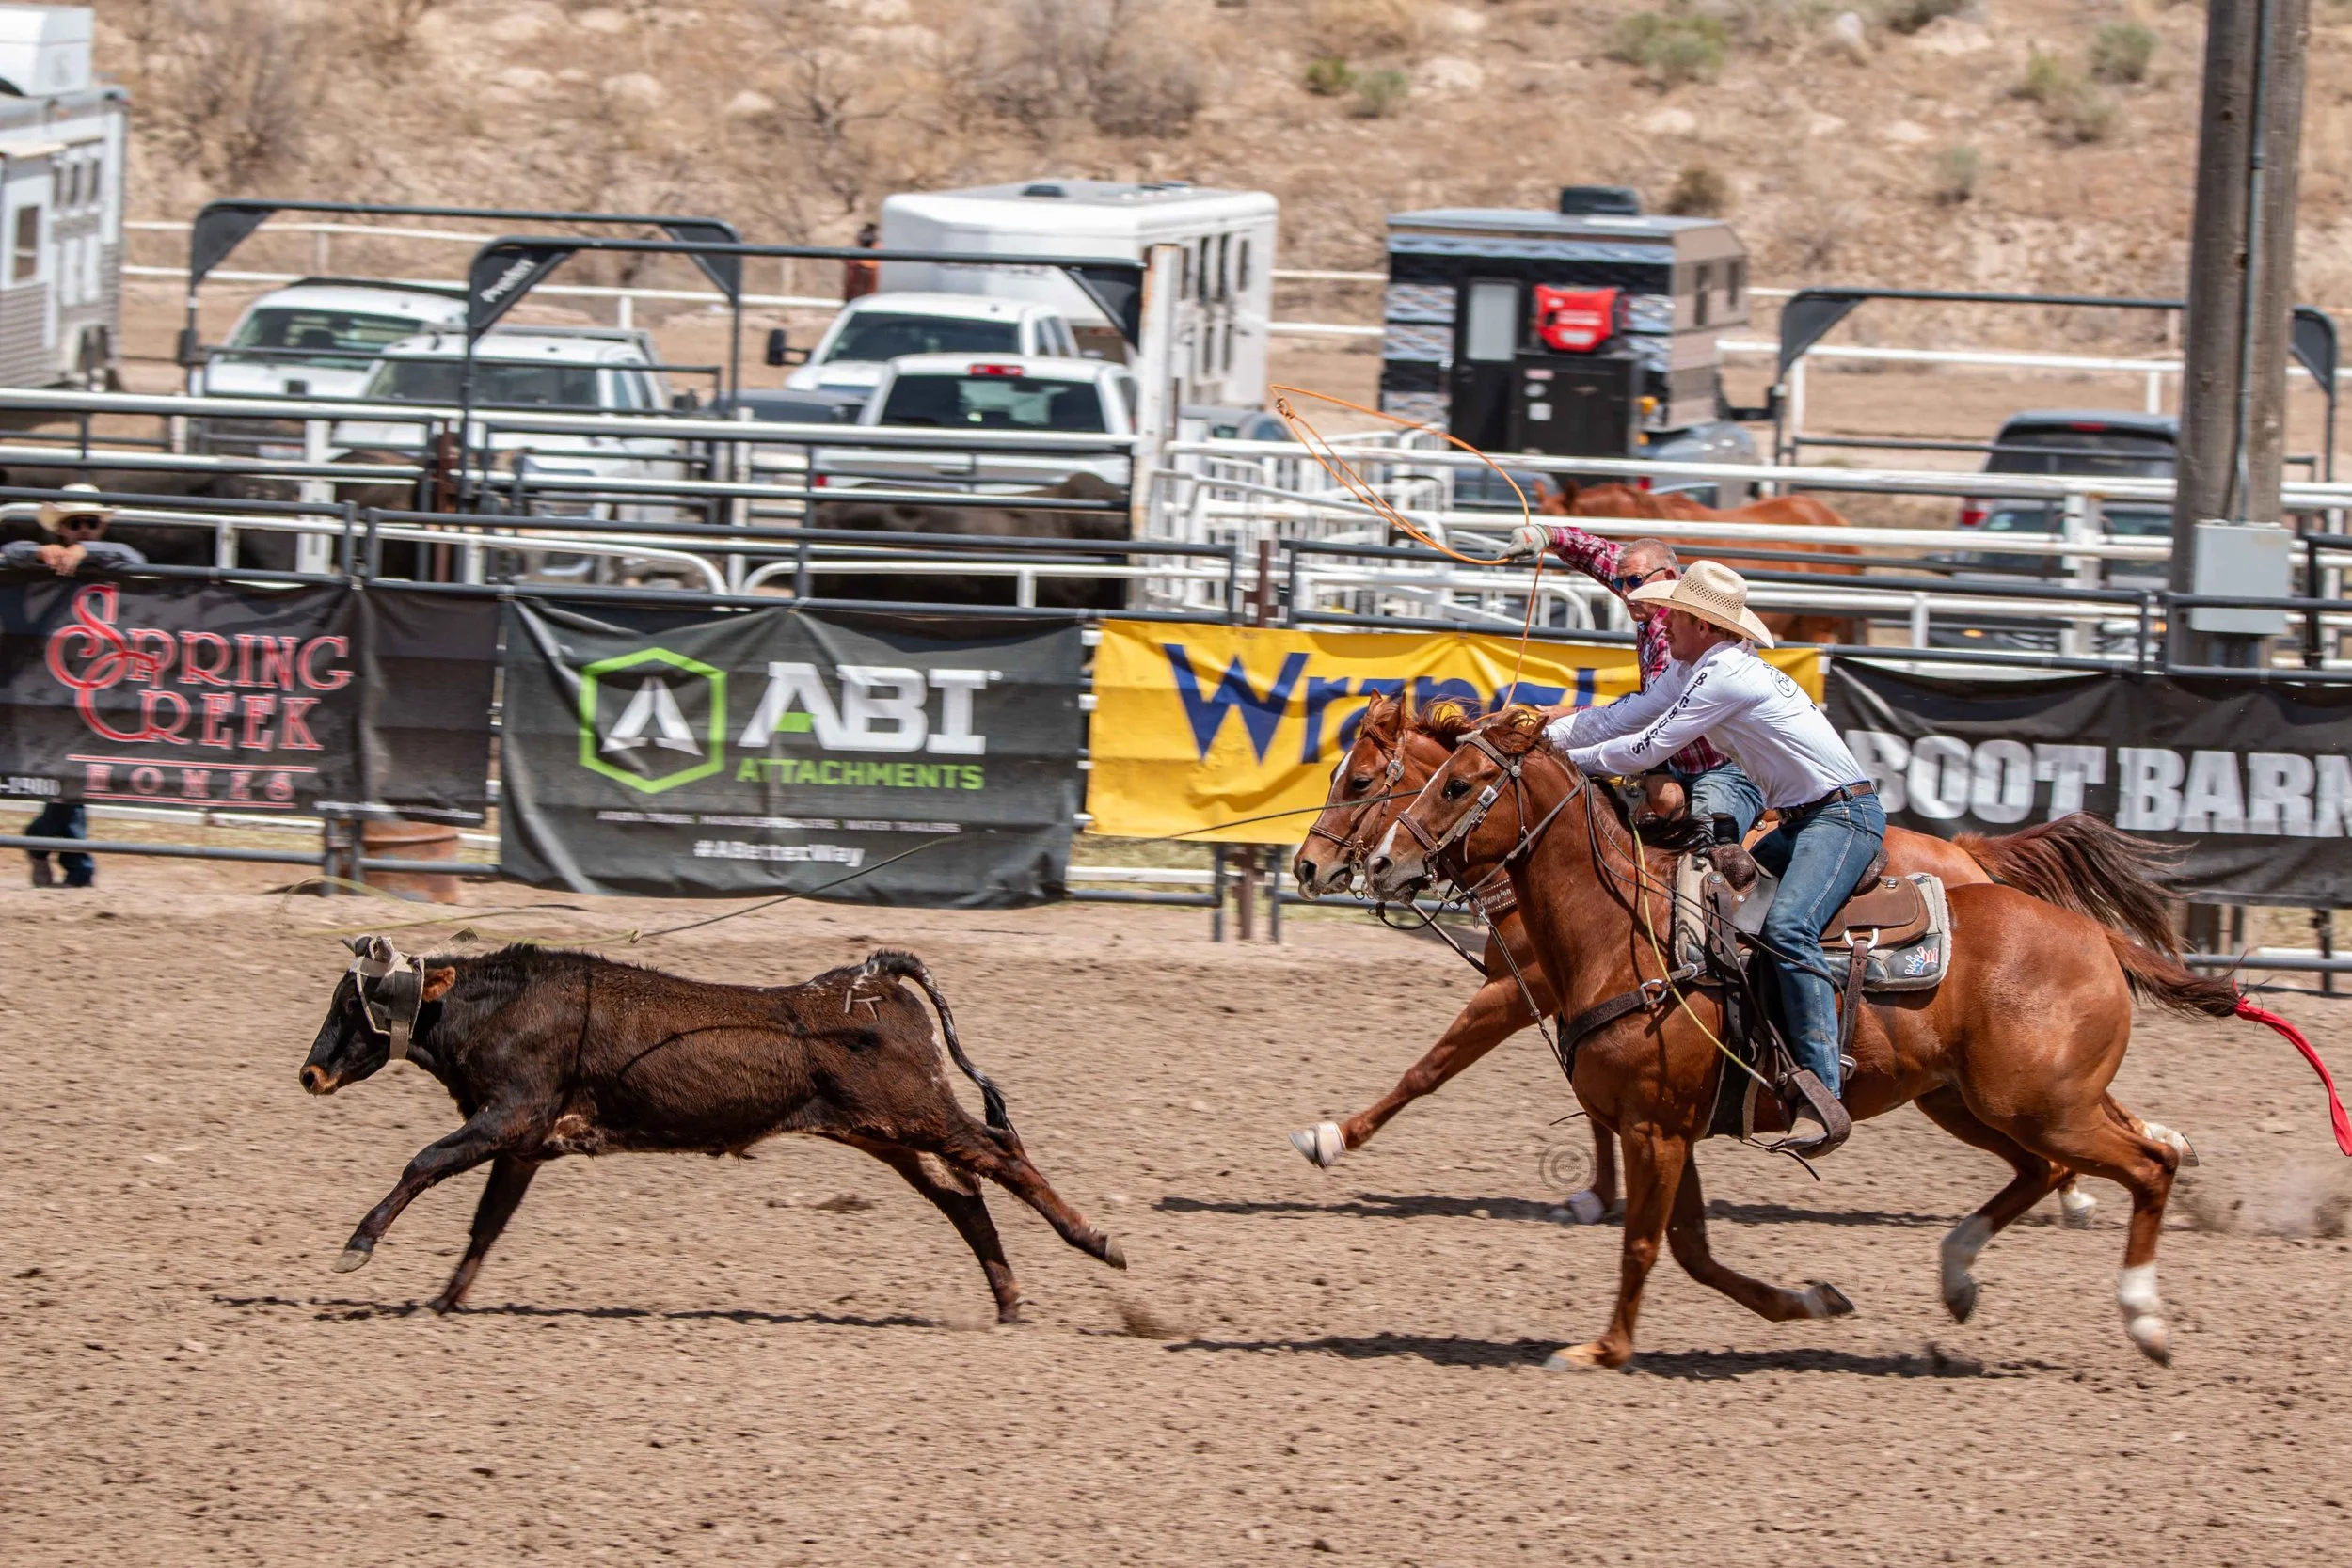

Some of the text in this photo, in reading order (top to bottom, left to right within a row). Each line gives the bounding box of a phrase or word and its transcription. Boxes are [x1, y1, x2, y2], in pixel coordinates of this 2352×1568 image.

[738, 661, 988, 755] ABI
[84, 763, 295, 801] HOMES
[736, 758, 985, 790] ATTACHMENTS
[1845, 729, 2106, 825] BOOT
